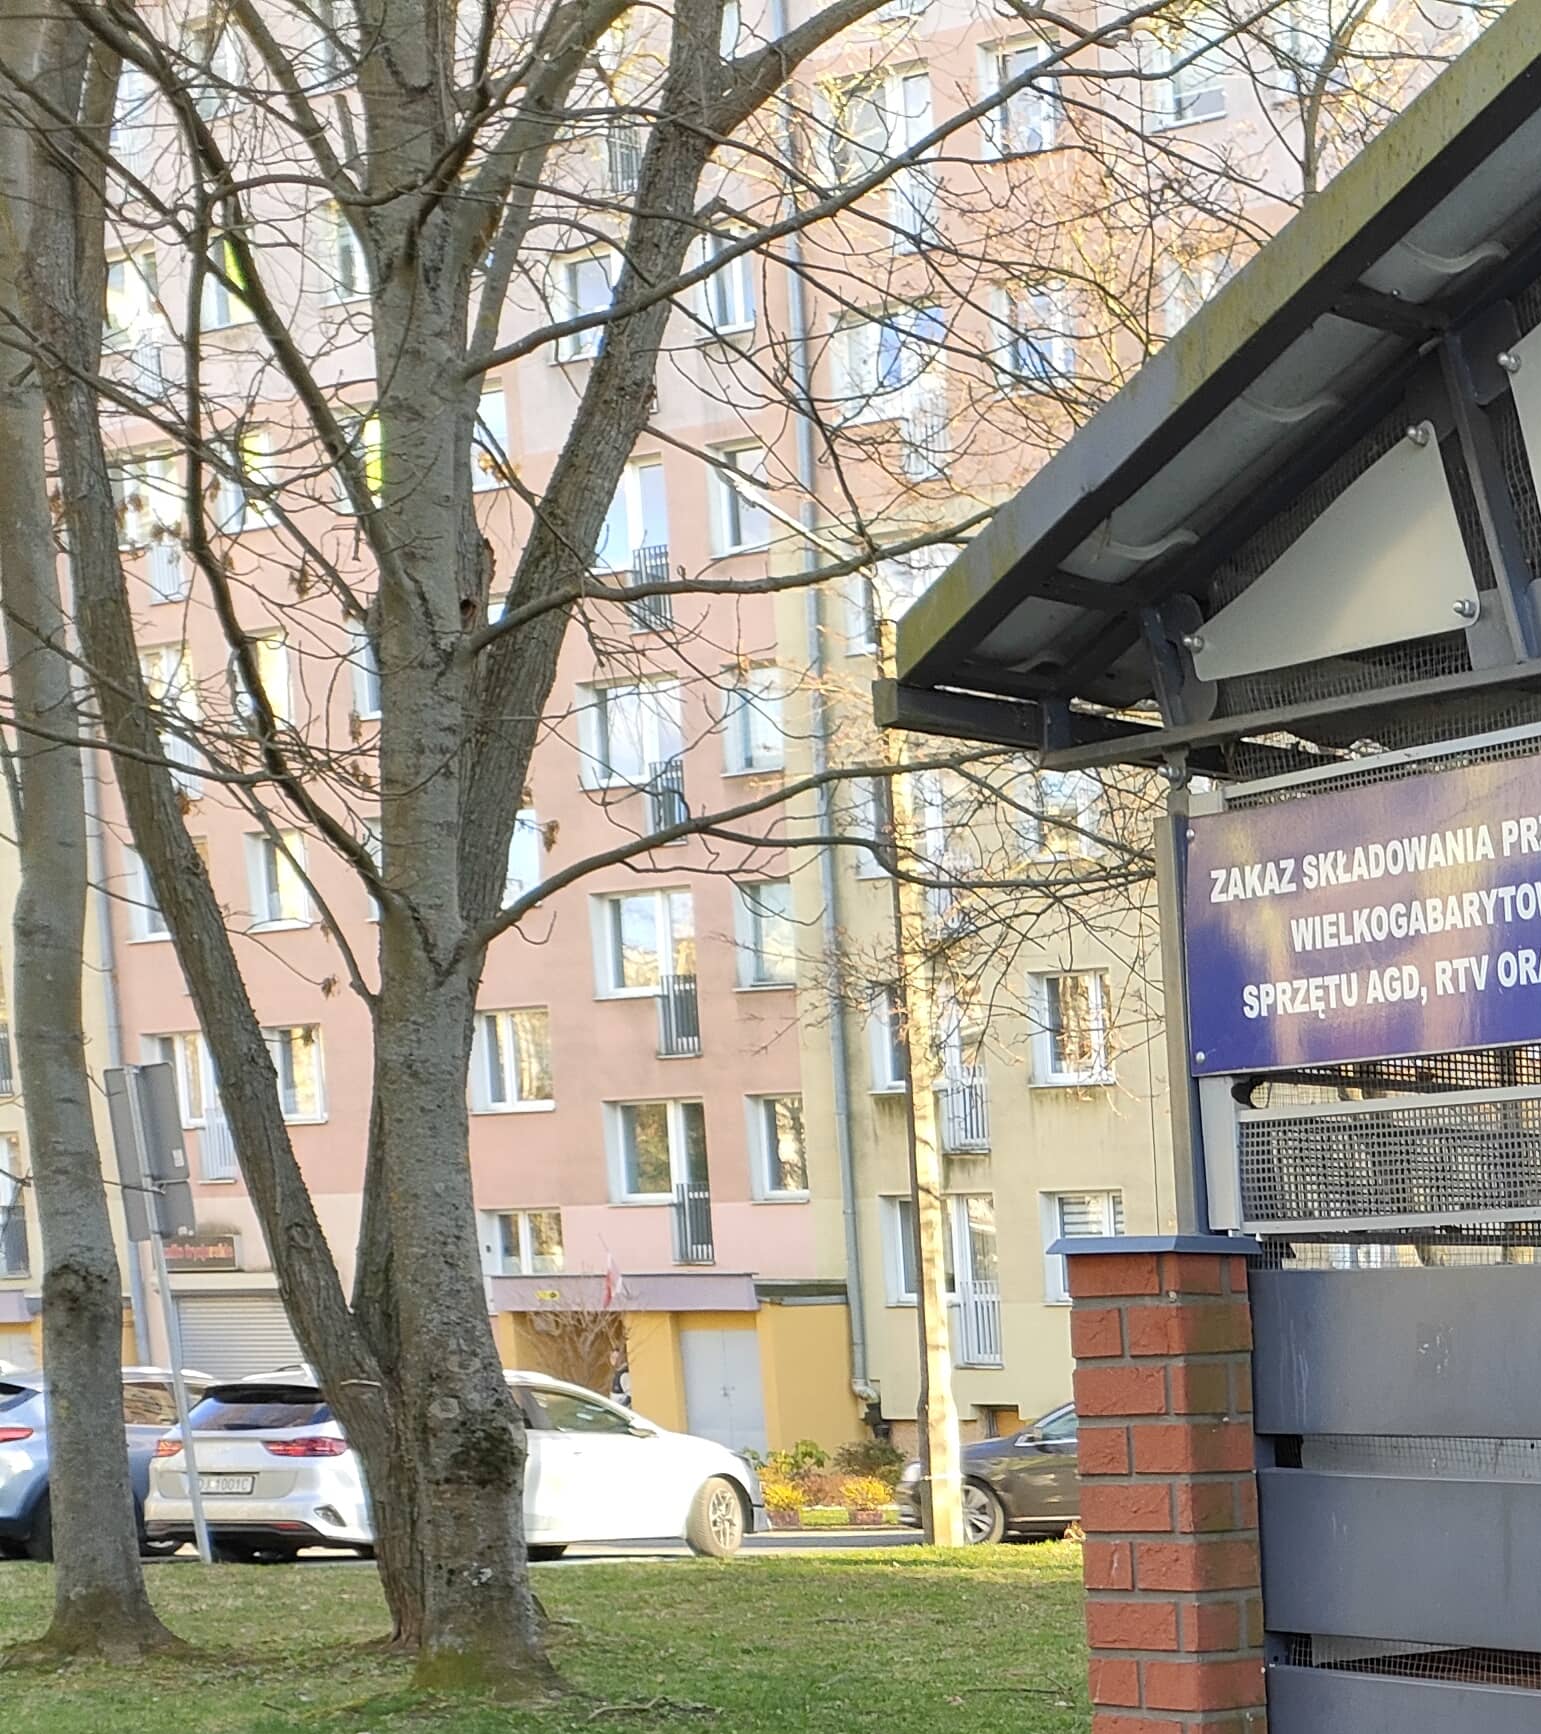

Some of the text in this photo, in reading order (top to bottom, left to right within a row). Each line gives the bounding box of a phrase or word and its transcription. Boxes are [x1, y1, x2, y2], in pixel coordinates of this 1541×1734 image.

[1209, 858, 1297, 904] ZAKAZ
[1302, 824, 1495, 890] SKŁADOWANIA
[1242, 973, 1359, 1020] SPRZĘTU
[1366, 964, 1428, 1006] AGD,
[1435, 954, 1489, 997] RTV
